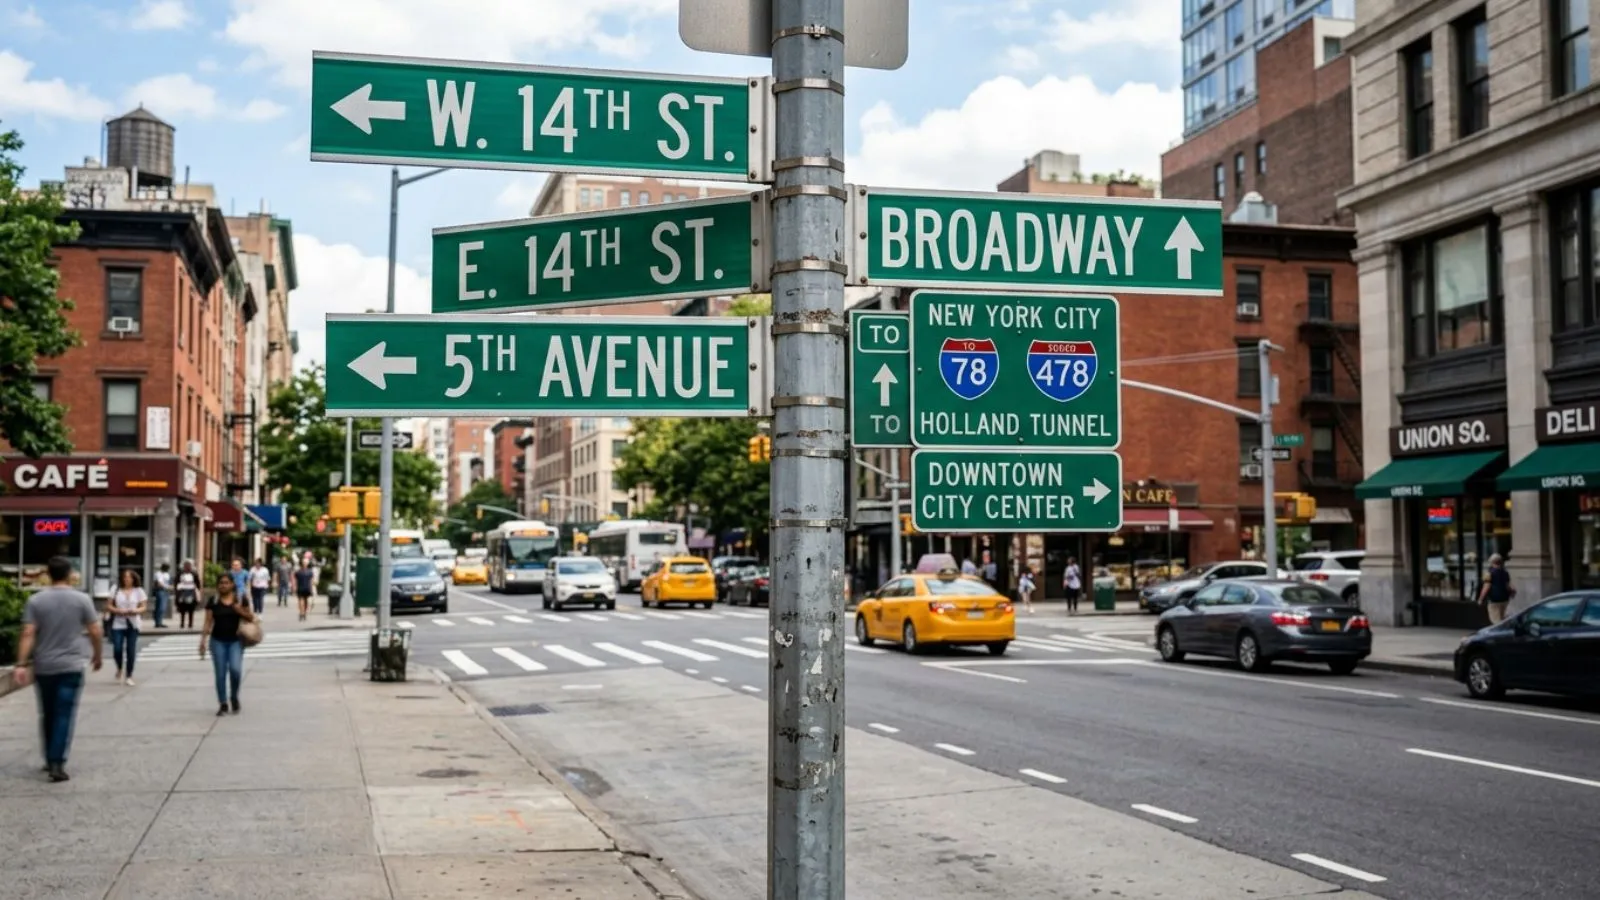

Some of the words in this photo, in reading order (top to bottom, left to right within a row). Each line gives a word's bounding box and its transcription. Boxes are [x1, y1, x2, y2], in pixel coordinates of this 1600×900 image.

[426, 79, 488, 150] W.
[518, 84, 630, 153] 14TH
[657, 92, 735, 162] ST.
[881, 206, 1144, 276] BROADWAY
[458, 241, 497, 301] E.
[525, 227, 621, 293] 14TH
[649, 217, 724, 286] ST.
[929, 303, 975, 327] NEW
[985, 305, 1043, 328] YORK
[1054, 307, 1101, 330] CITY
[869, 325, 900, 344] TO
[963, 342, 976, 351] TO
[444, 334, 516, 398] 5TH
[538, 335, 735, 399] AVENUE
[951, 358, 987, 386] 78
[1036, 359, 1089, 388] 478
[870, 414, 901, 434] TO
[920, 411, 1020, 436] HOLLAND
[1030, 413, 1112, 437] TUNNEL
[1546, 406, 1596, 436] DELI
[1399, 424, 1454, 451] UNION
[1458, 420, 1491, 444] SQ.
[929, 461, 1063, 487] DOWNTOWN
[922, 494, 974, 519] CITY
[985, 494, 1075, 520] CENTER
